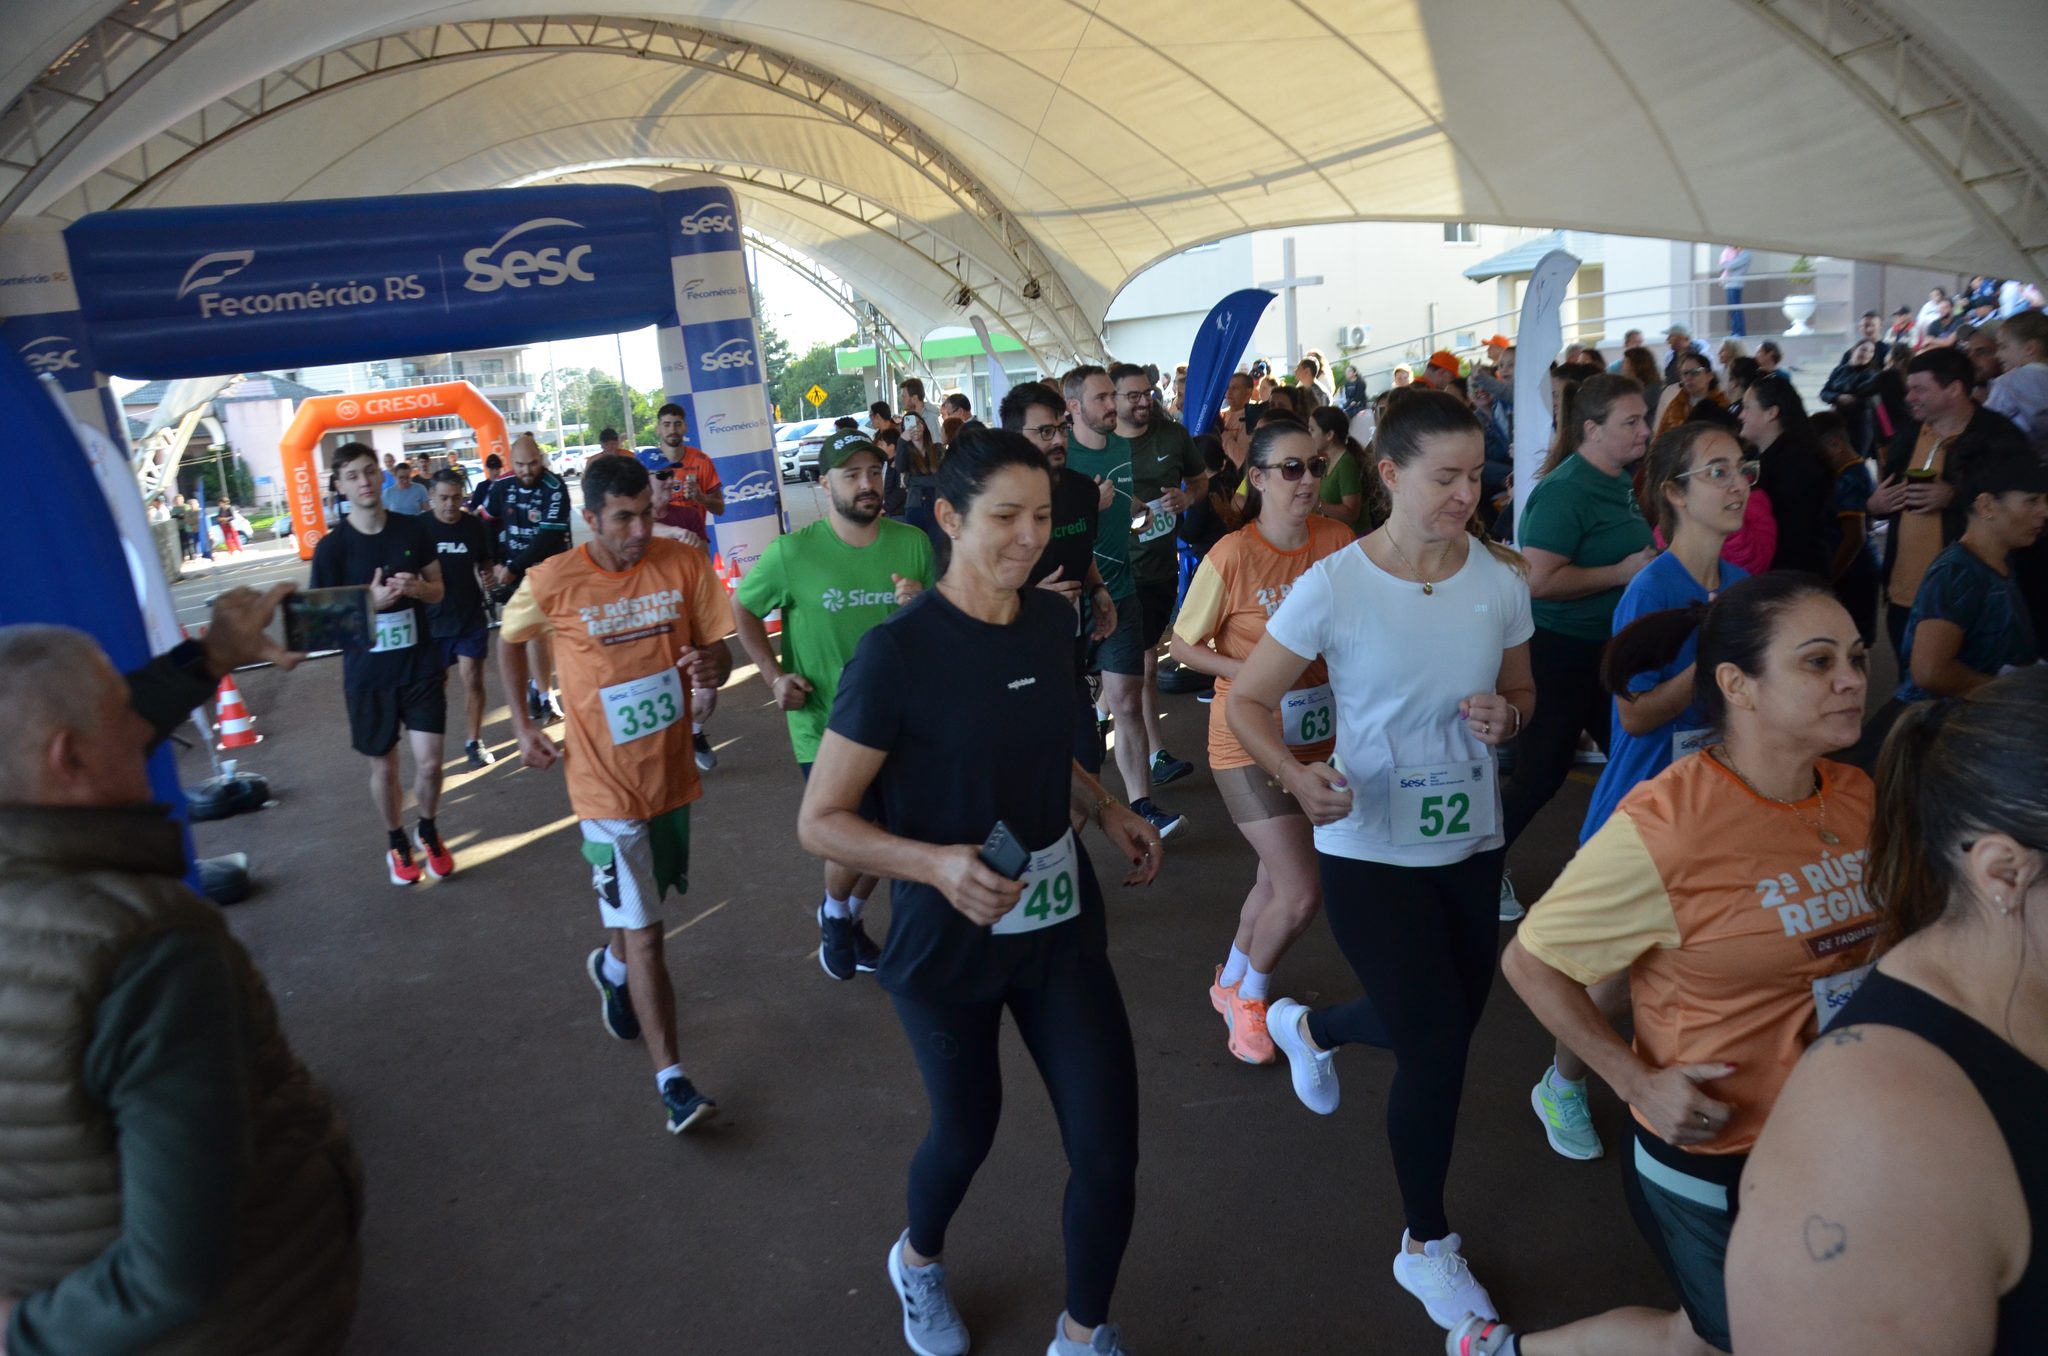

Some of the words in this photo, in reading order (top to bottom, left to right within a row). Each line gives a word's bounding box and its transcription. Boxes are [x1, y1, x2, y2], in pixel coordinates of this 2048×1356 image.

[681, 214, 734, 236] Sesc
[463, 244, 595, 292] Sesc
[199, 281, 377, 318] Fecomércio
[384, 275, 425, 301] RS
[687, 287, 737, 300] Fecomércio
[24, 349, 80, 371] esc
[701, 348, 754, 372] Sesc
[365, 392, 444, 415] CRESOL
[710, 420, 759, 434] Fecomércio
[294, 461, 317, 525] CRESOL
[1051, 518, 1087, 539] credi
[437, 542, 468, 554] FILA
[603, 588, 683, 618] RÚSTICA
[587, 604, 681, 636] REGIONAL
[376, 624, 412, 647] 157
[617, 692, 677, 736] 333
[1301, 706, 1330, 740] 63
[1400, 778, 1427, 788] Sesc
[1419, 792, 1471, 838] 52
[1024, 870, 1073, 921] 49
[1817, 938, 1832, 952] DE
